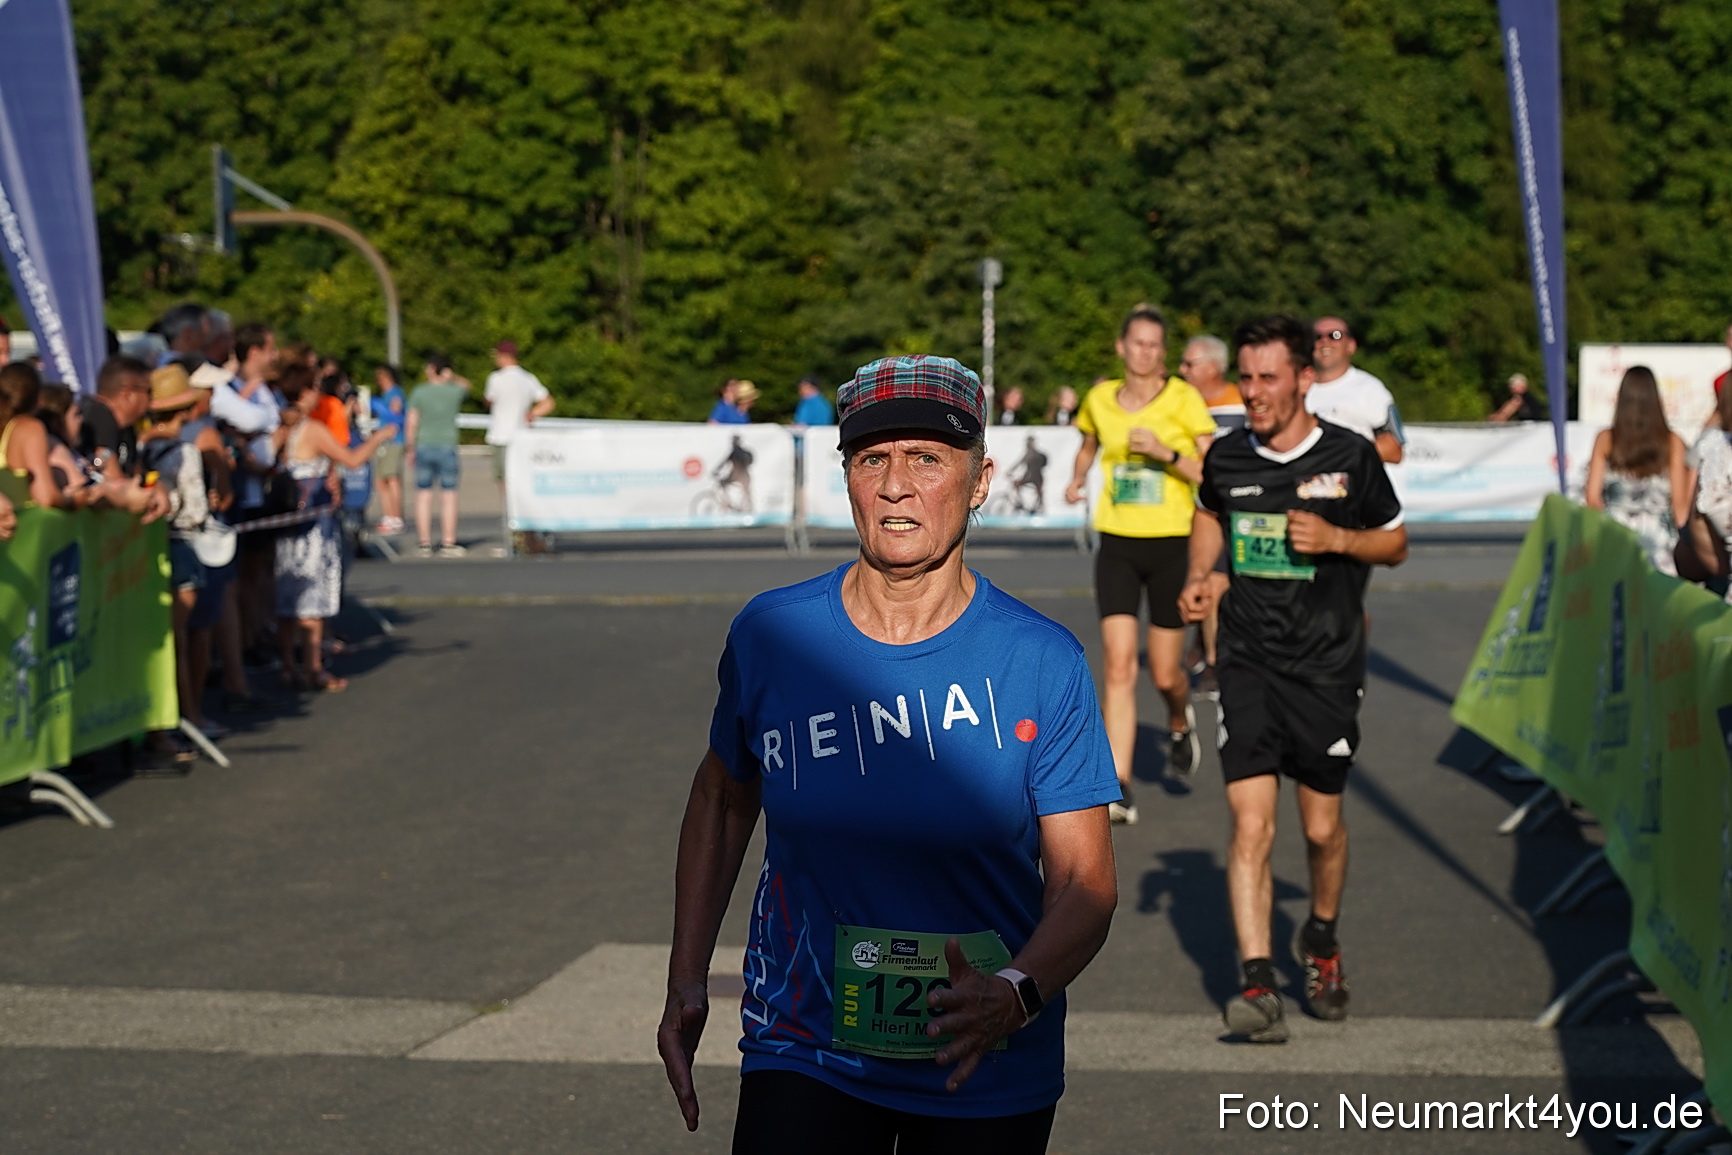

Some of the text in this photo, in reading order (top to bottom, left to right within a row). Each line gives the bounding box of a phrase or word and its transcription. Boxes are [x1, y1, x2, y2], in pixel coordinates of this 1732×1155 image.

[882, 955, 939, 965] Firmenlauf
[843, 984, 859, 1027] RUN
[871, 1019, 928, 1036] Hierl M
